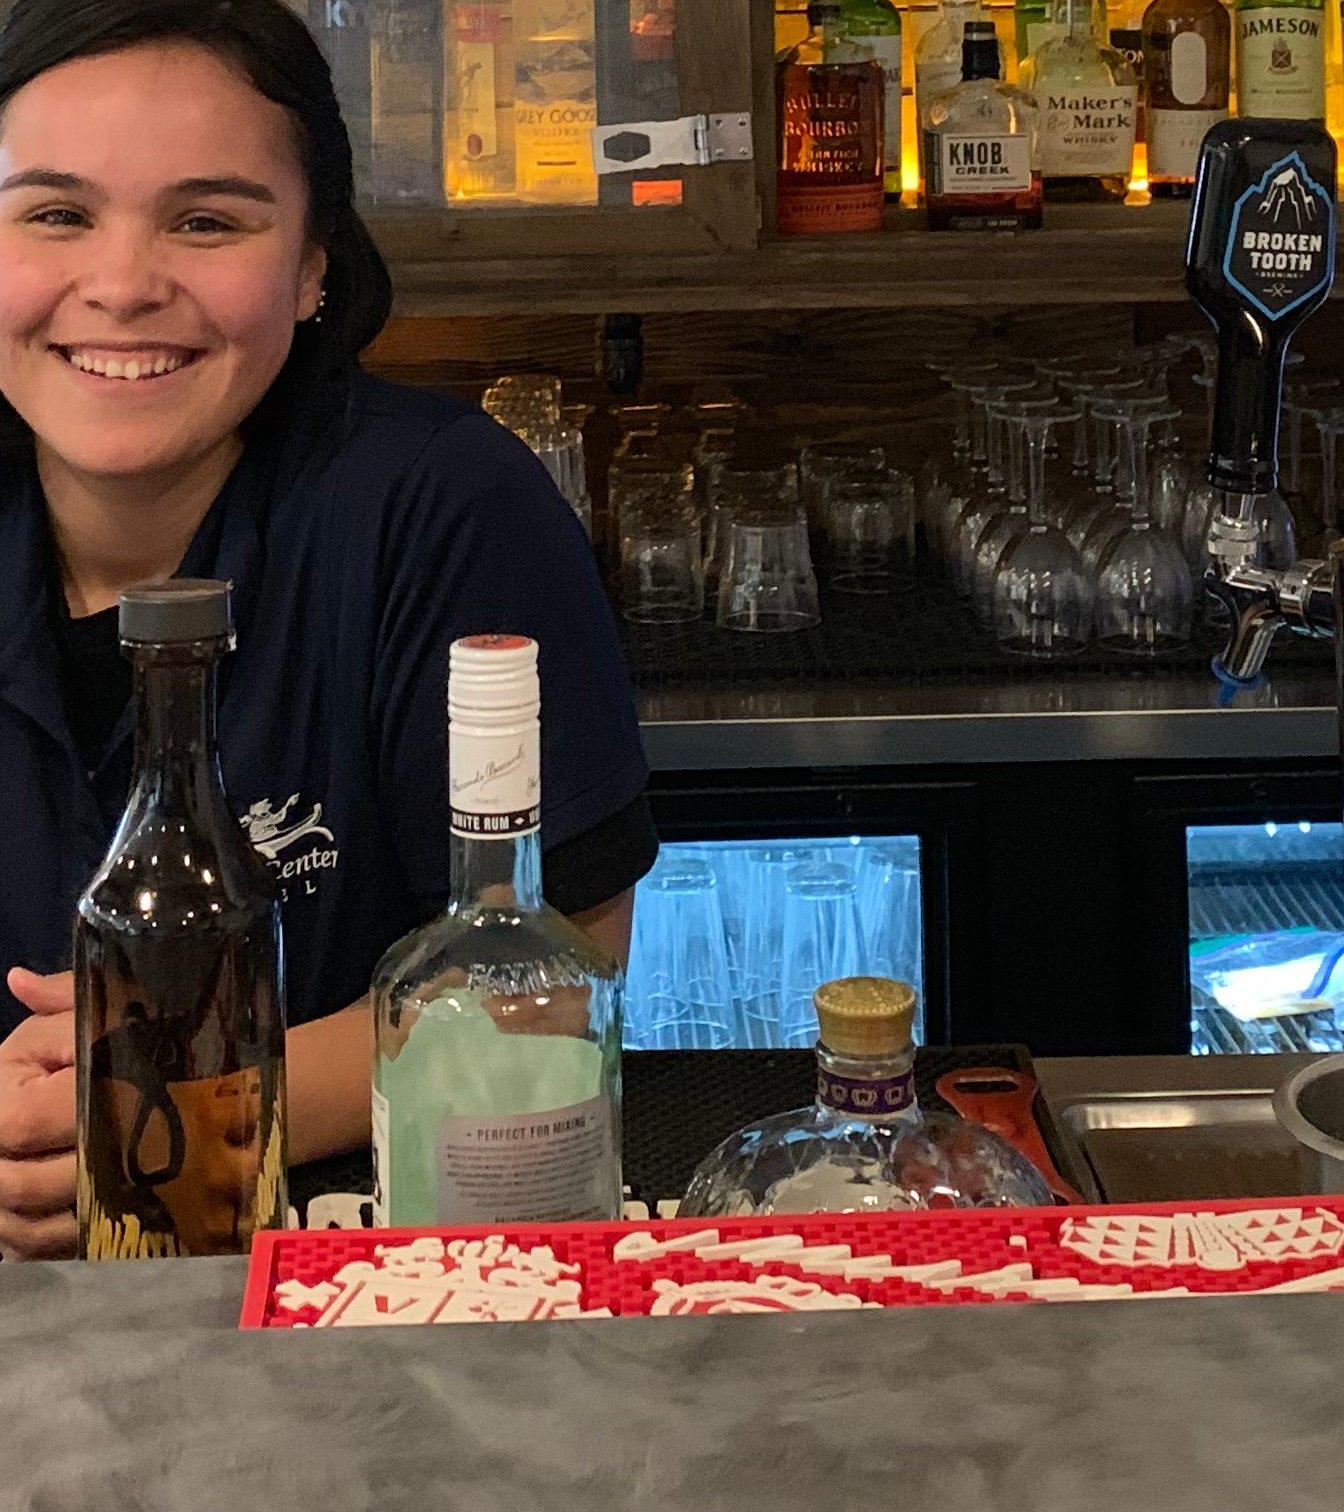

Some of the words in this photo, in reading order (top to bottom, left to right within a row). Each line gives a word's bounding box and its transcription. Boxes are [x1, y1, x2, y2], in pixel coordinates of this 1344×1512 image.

[1241, 17, 1321, 39] JAMESON
[1047, 95, 1133, 111] Maker's
[549, 108, 595, 124] GOOS
[1073, 113, 1132, 129] Mark
[949, 141, 1003, 166] KNOB
[955, 165, 1010, 176] CREEK
[1242, 231, 1323, 253] BROKEN
[1250, 251, 1313, 271] TOOTH
[484, 815, 510, 831] RUM
[477, 1128, 526, 1141] PERFECT
[530, 1124, 550, 1138] FOR
